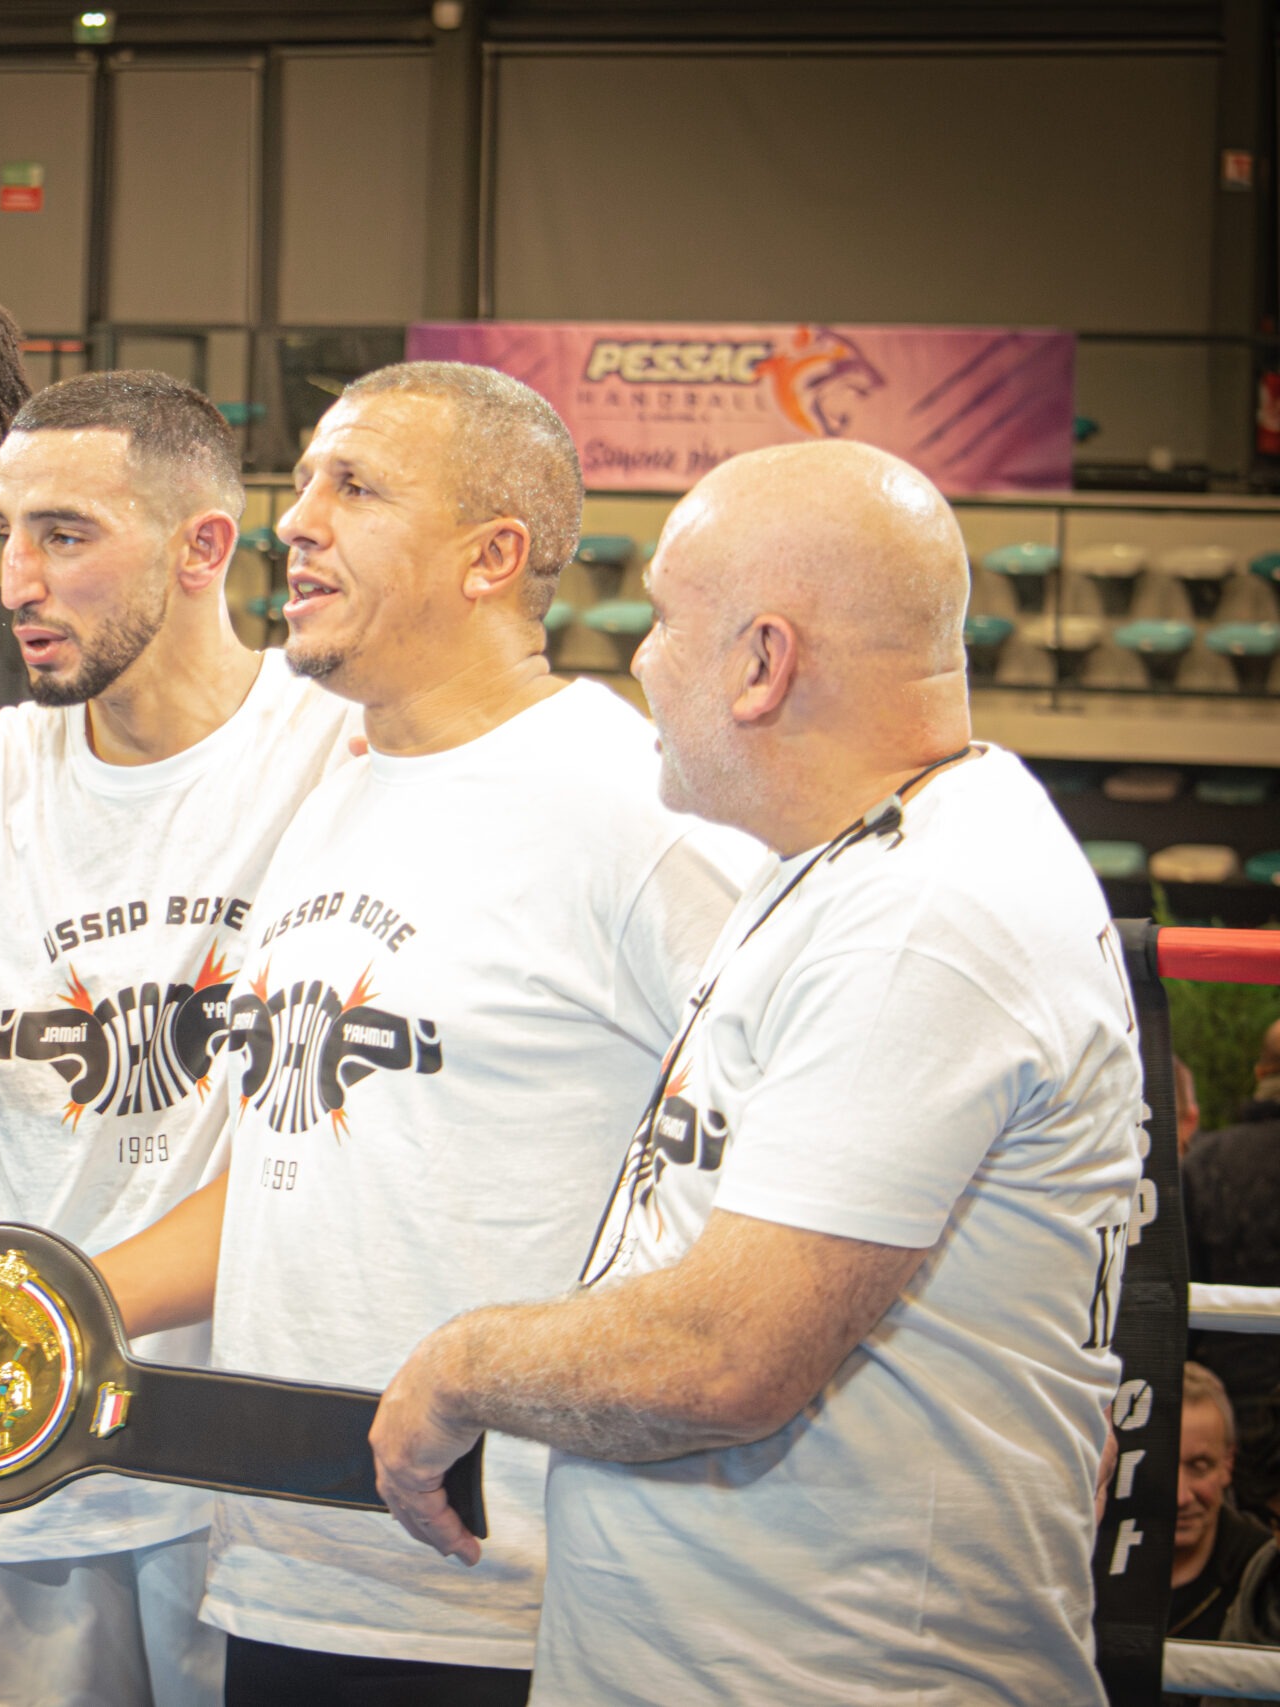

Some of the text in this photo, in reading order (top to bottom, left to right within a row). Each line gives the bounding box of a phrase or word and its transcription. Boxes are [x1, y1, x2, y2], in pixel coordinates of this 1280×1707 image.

[582, 339, 772, 385] PESSAC
[43, 901, 149, 963] USSAP
[260, 891, 417, 954] USSAP BOXE
[39, 1022, 88, 1042] JAMAÏ
[119, 1134, 169, 1165] 1999
